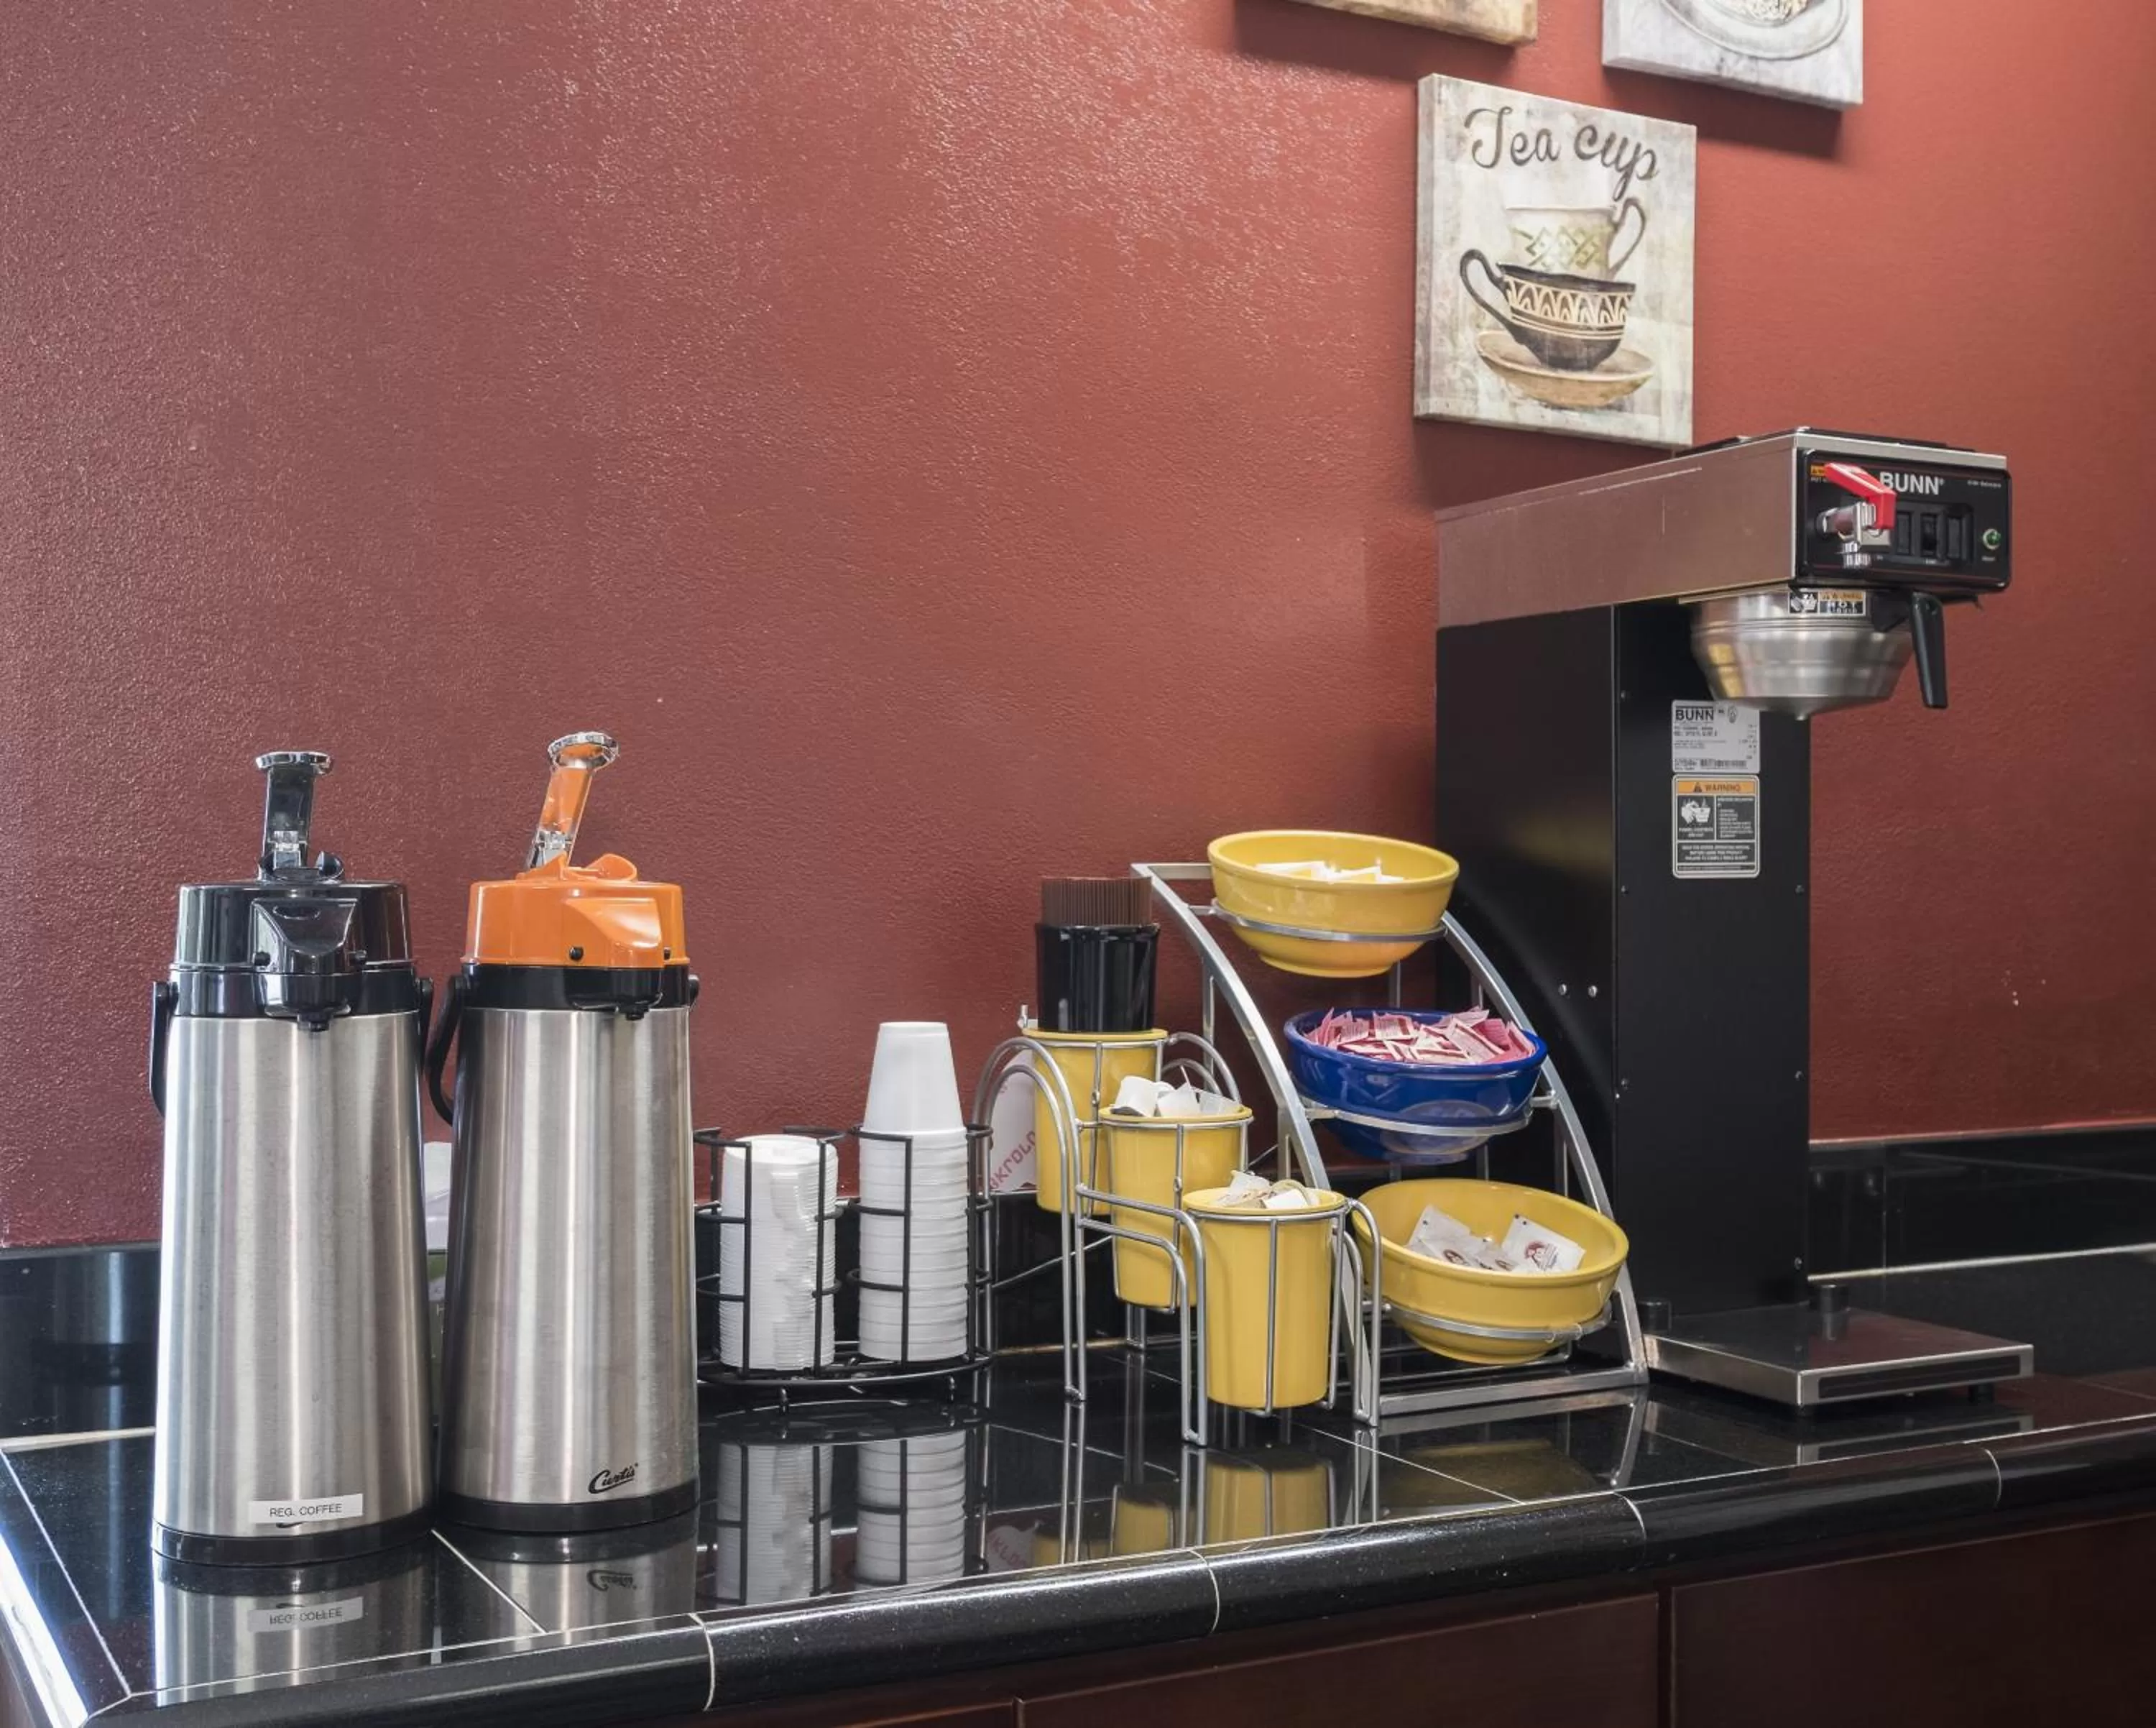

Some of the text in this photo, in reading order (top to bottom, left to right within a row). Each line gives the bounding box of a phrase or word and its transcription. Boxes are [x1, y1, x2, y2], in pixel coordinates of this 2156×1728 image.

[1464, 106, 1659, 202] Tea cup
[1880, 472, 1939, 495] BUNN
[1675, 709, 1714, 721] BUNN
[589, 1466, 635, 1494] Curtis
[270, 1503, 343, 1517] REG. COFFEE
